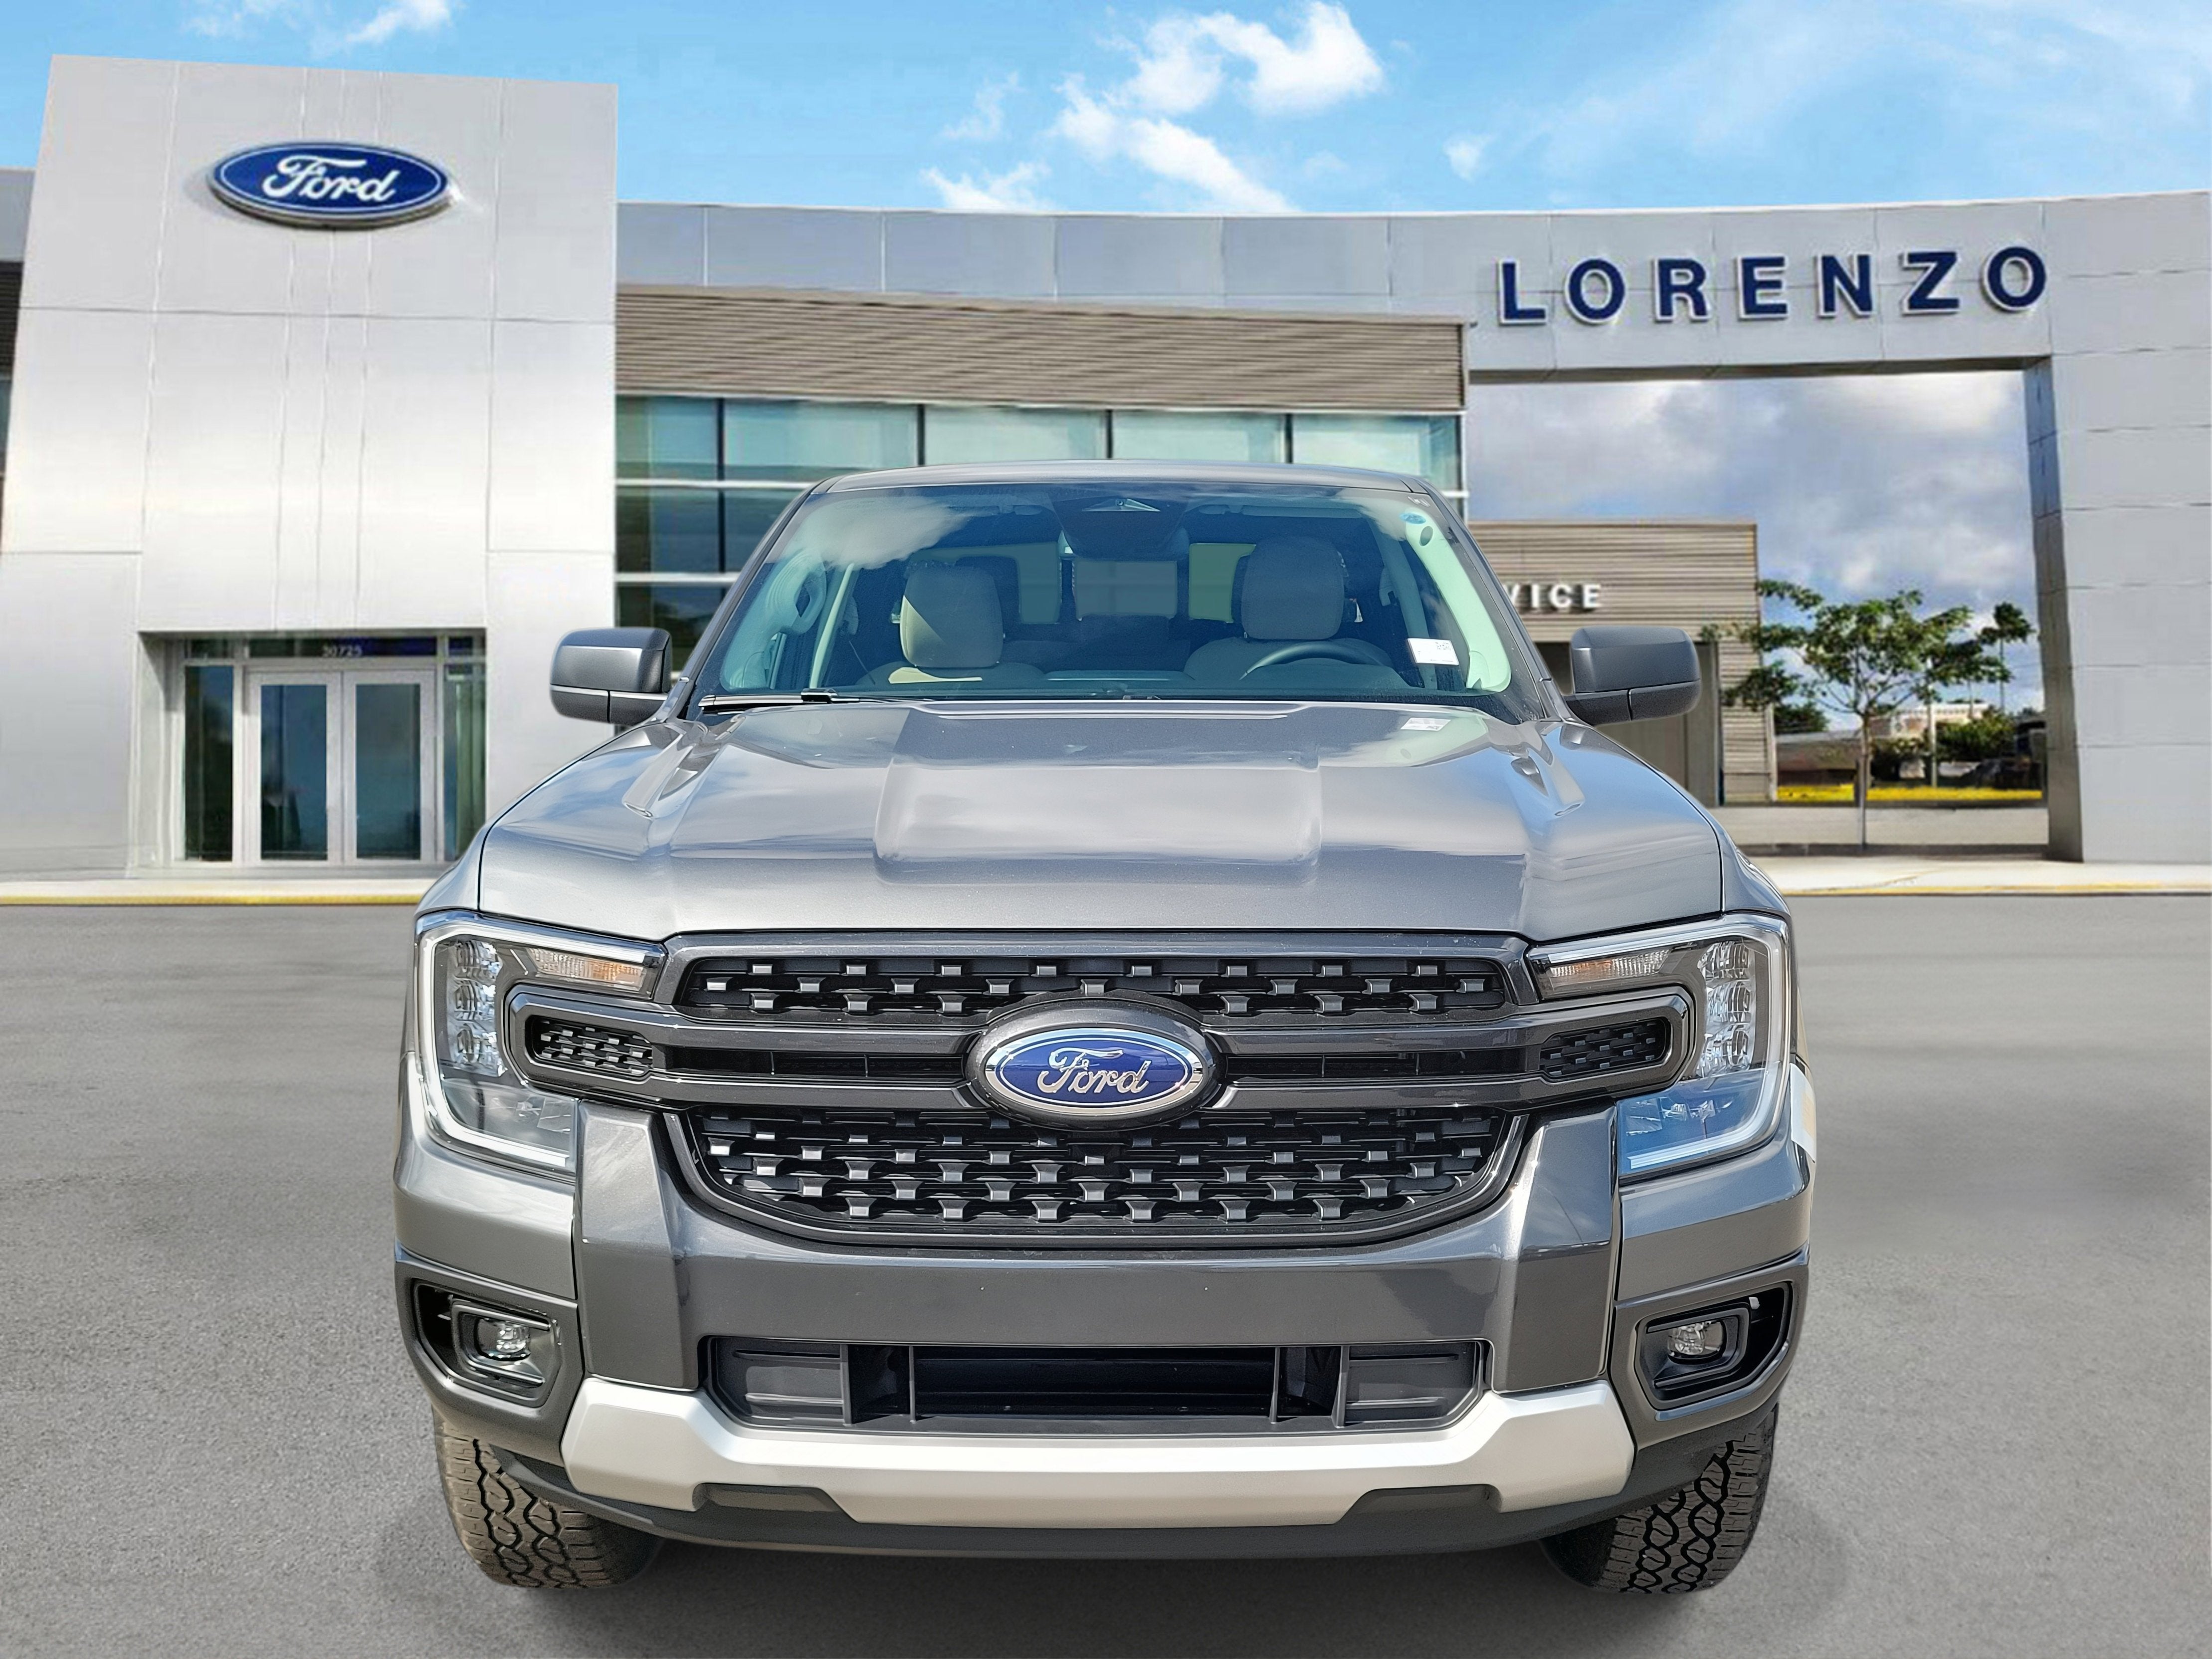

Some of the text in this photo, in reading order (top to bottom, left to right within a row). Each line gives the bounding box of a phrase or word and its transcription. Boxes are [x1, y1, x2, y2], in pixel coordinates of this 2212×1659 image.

[262, 154, 400, 202] Ford
[1498, 246, 2047, 324] LORENZO
[1037, 1047, 1152, 1094] Ford
